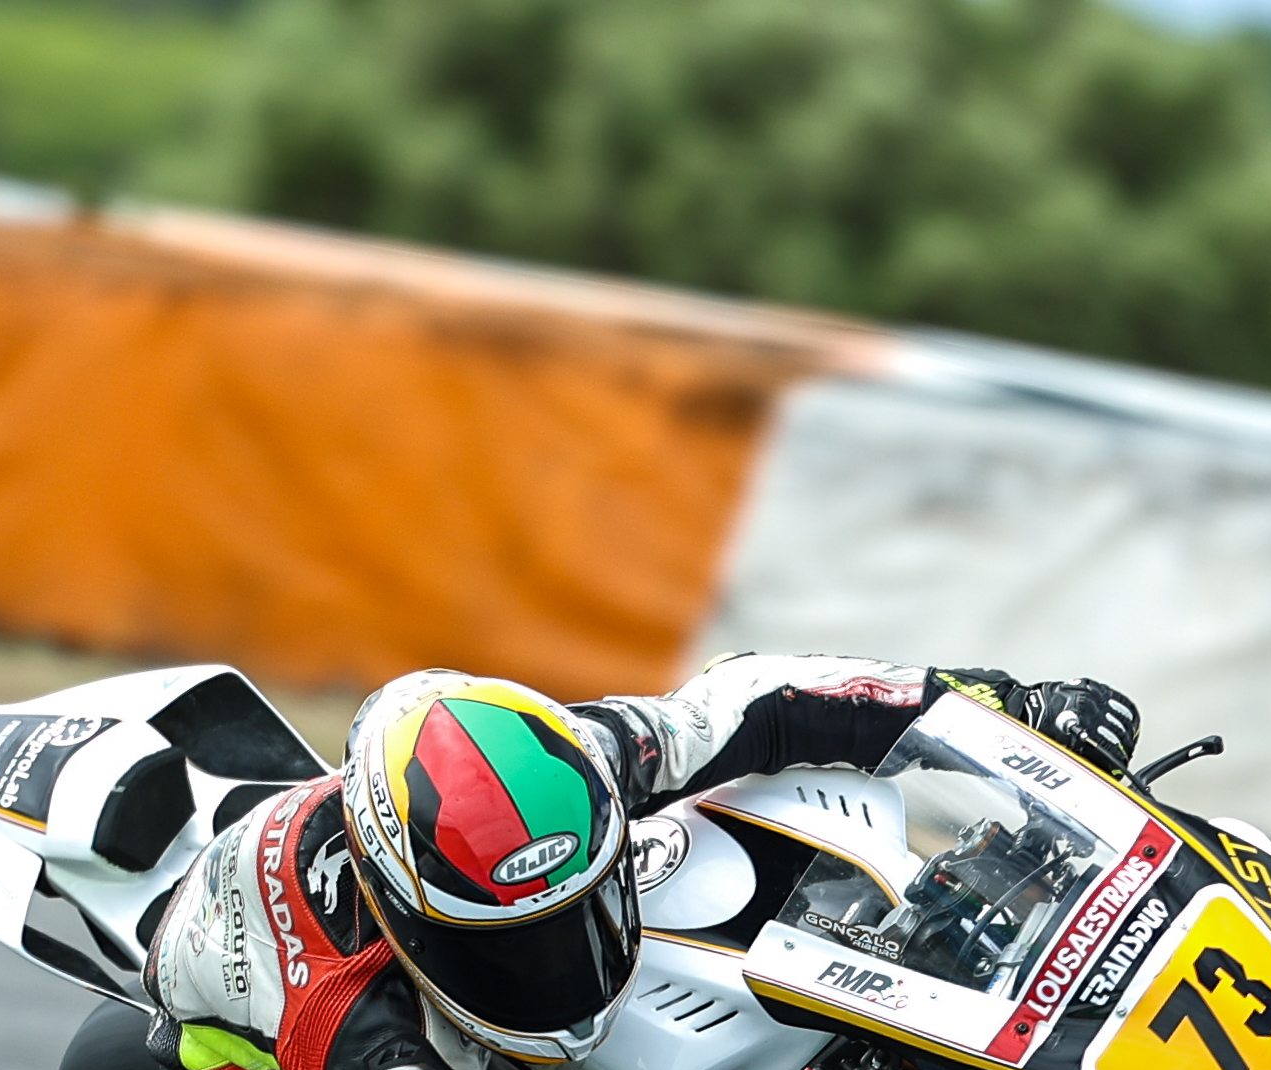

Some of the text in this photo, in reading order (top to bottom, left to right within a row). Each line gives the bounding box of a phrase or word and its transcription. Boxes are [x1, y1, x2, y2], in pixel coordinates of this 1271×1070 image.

[372, 772, 400, 839] GR73
[358, 807, 387, 858] LST
[506, 838, 566, 879] HJC
[816, 961, 890, 998] FMP
